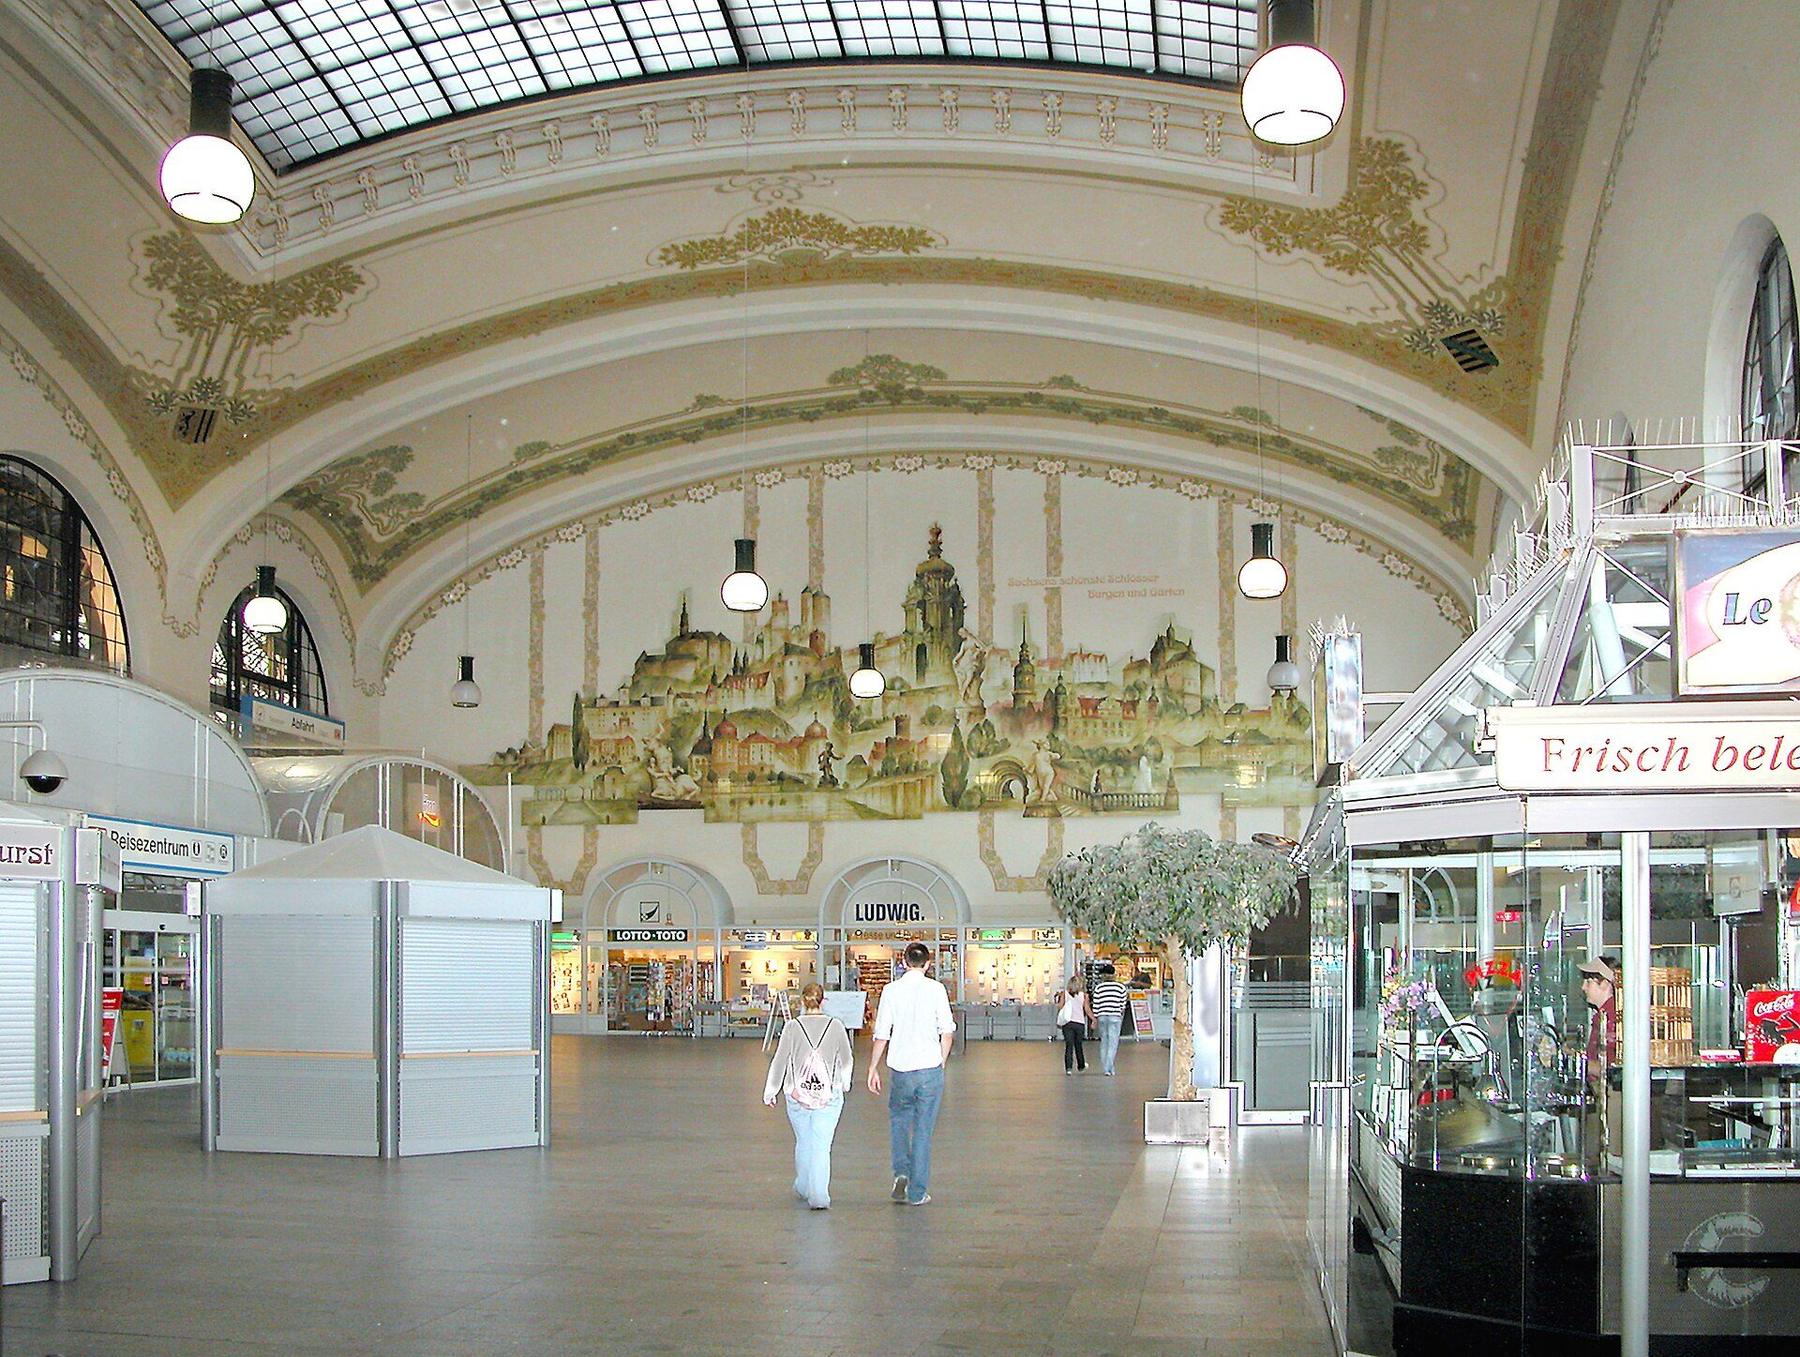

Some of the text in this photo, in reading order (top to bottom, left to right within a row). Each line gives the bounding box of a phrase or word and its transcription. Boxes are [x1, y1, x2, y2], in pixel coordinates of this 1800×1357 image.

[1722, 592, 1773, 626] Le
[291, 717, 316, 734] Abfahrt
[1541, 735, 1800, 773] Frisch bele
[110, 830, 190, 857] Reisezentrum
